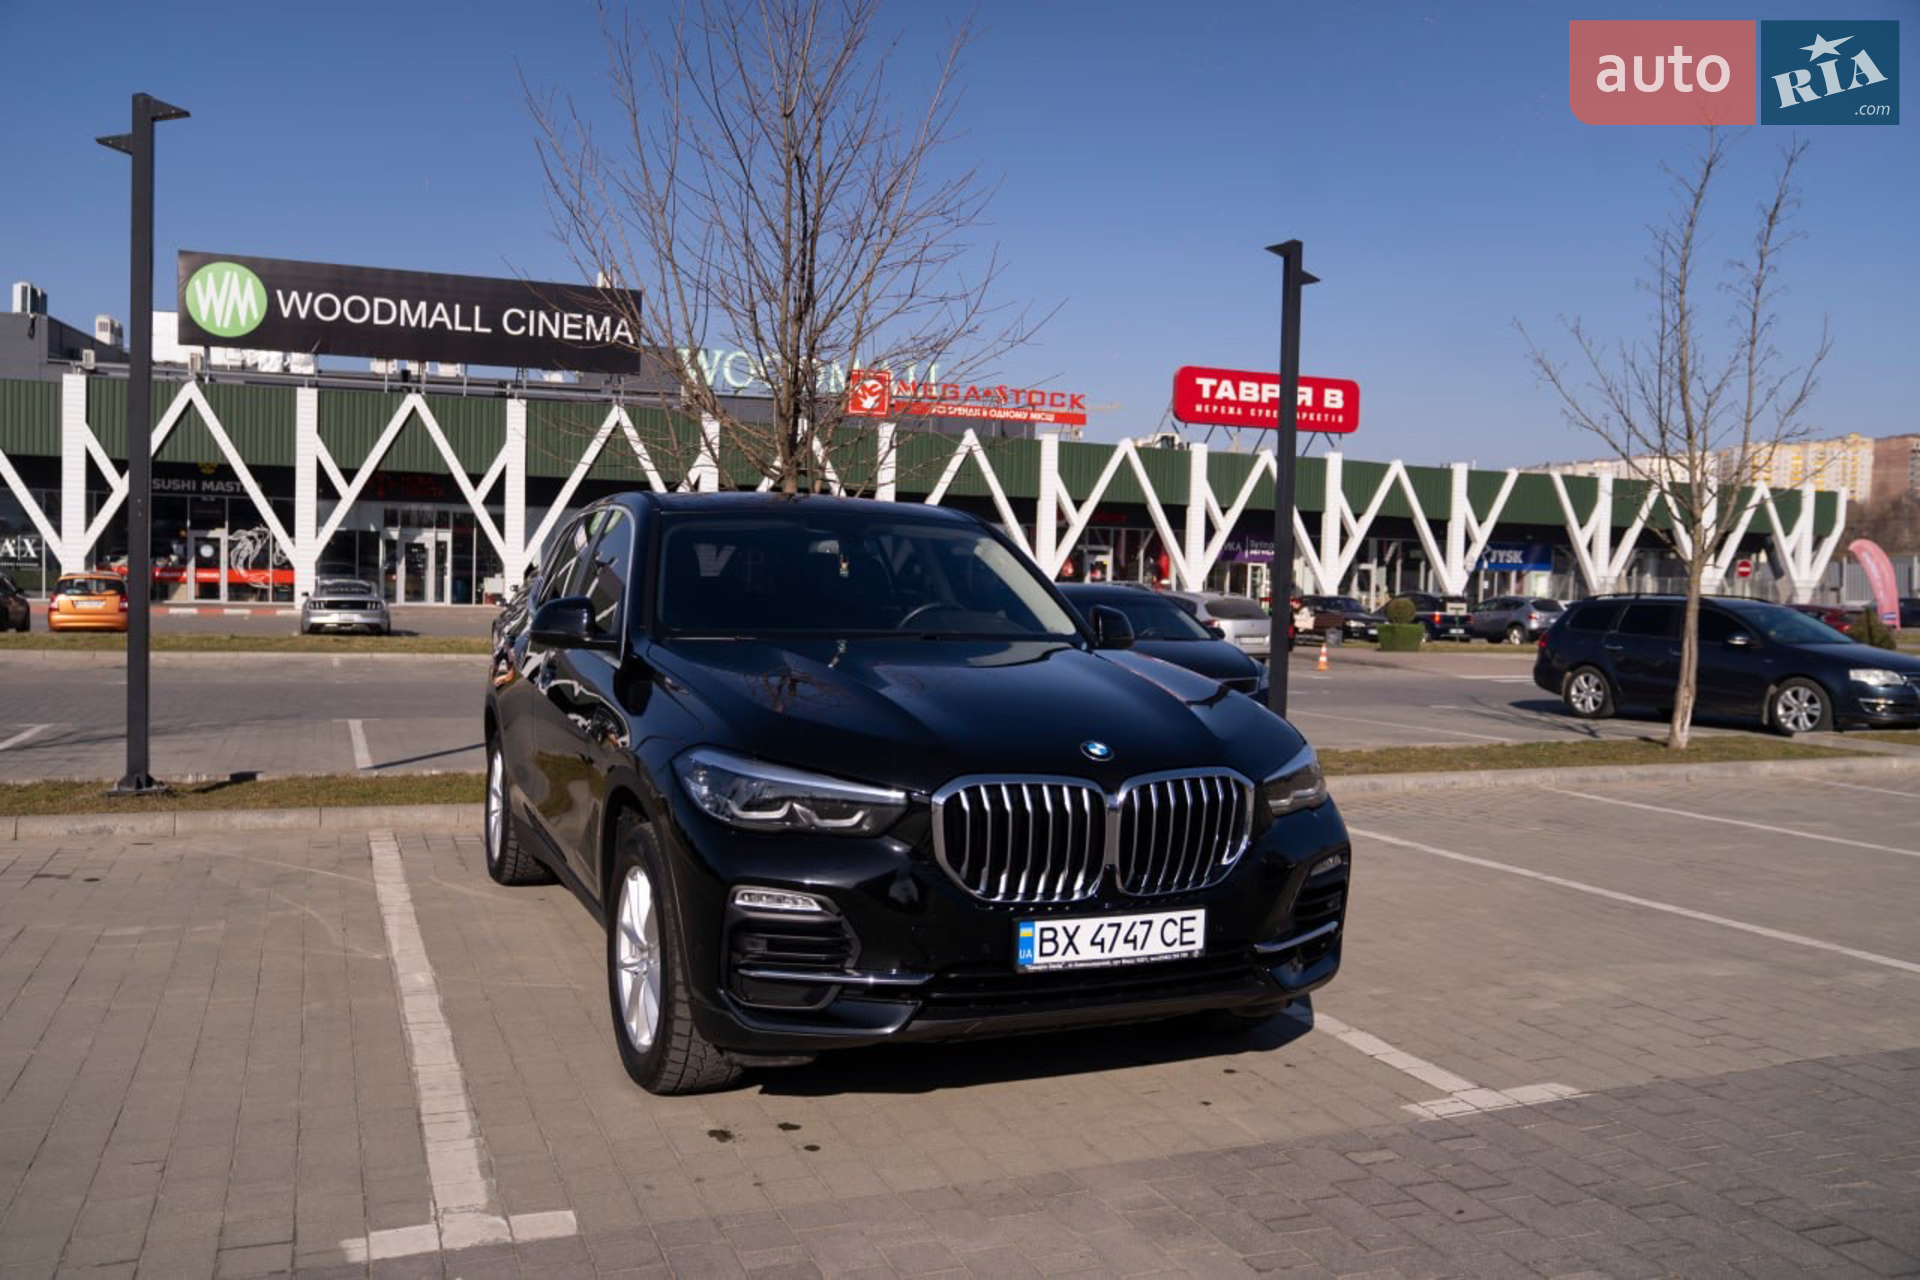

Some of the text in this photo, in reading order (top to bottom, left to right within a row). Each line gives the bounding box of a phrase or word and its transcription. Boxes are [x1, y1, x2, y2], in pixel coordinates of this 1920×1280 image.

[195, 270, 258, 328] WM
[276, 289, 635, 344] WOODMALL CINEMA
[1195, 377, 1345, 409] ТАВРЯ В
[1195, 404, 1344, 424] МЕРЕЖА СУПЕАРКЕТІВ
[152, 478, 262, 495] SUSHI MAST
[1489, 550, 1524, 564] JYSK
[1039, 915, 1198, 958] BX 4747 CE
[1019, 948, 1033, 959] UA
